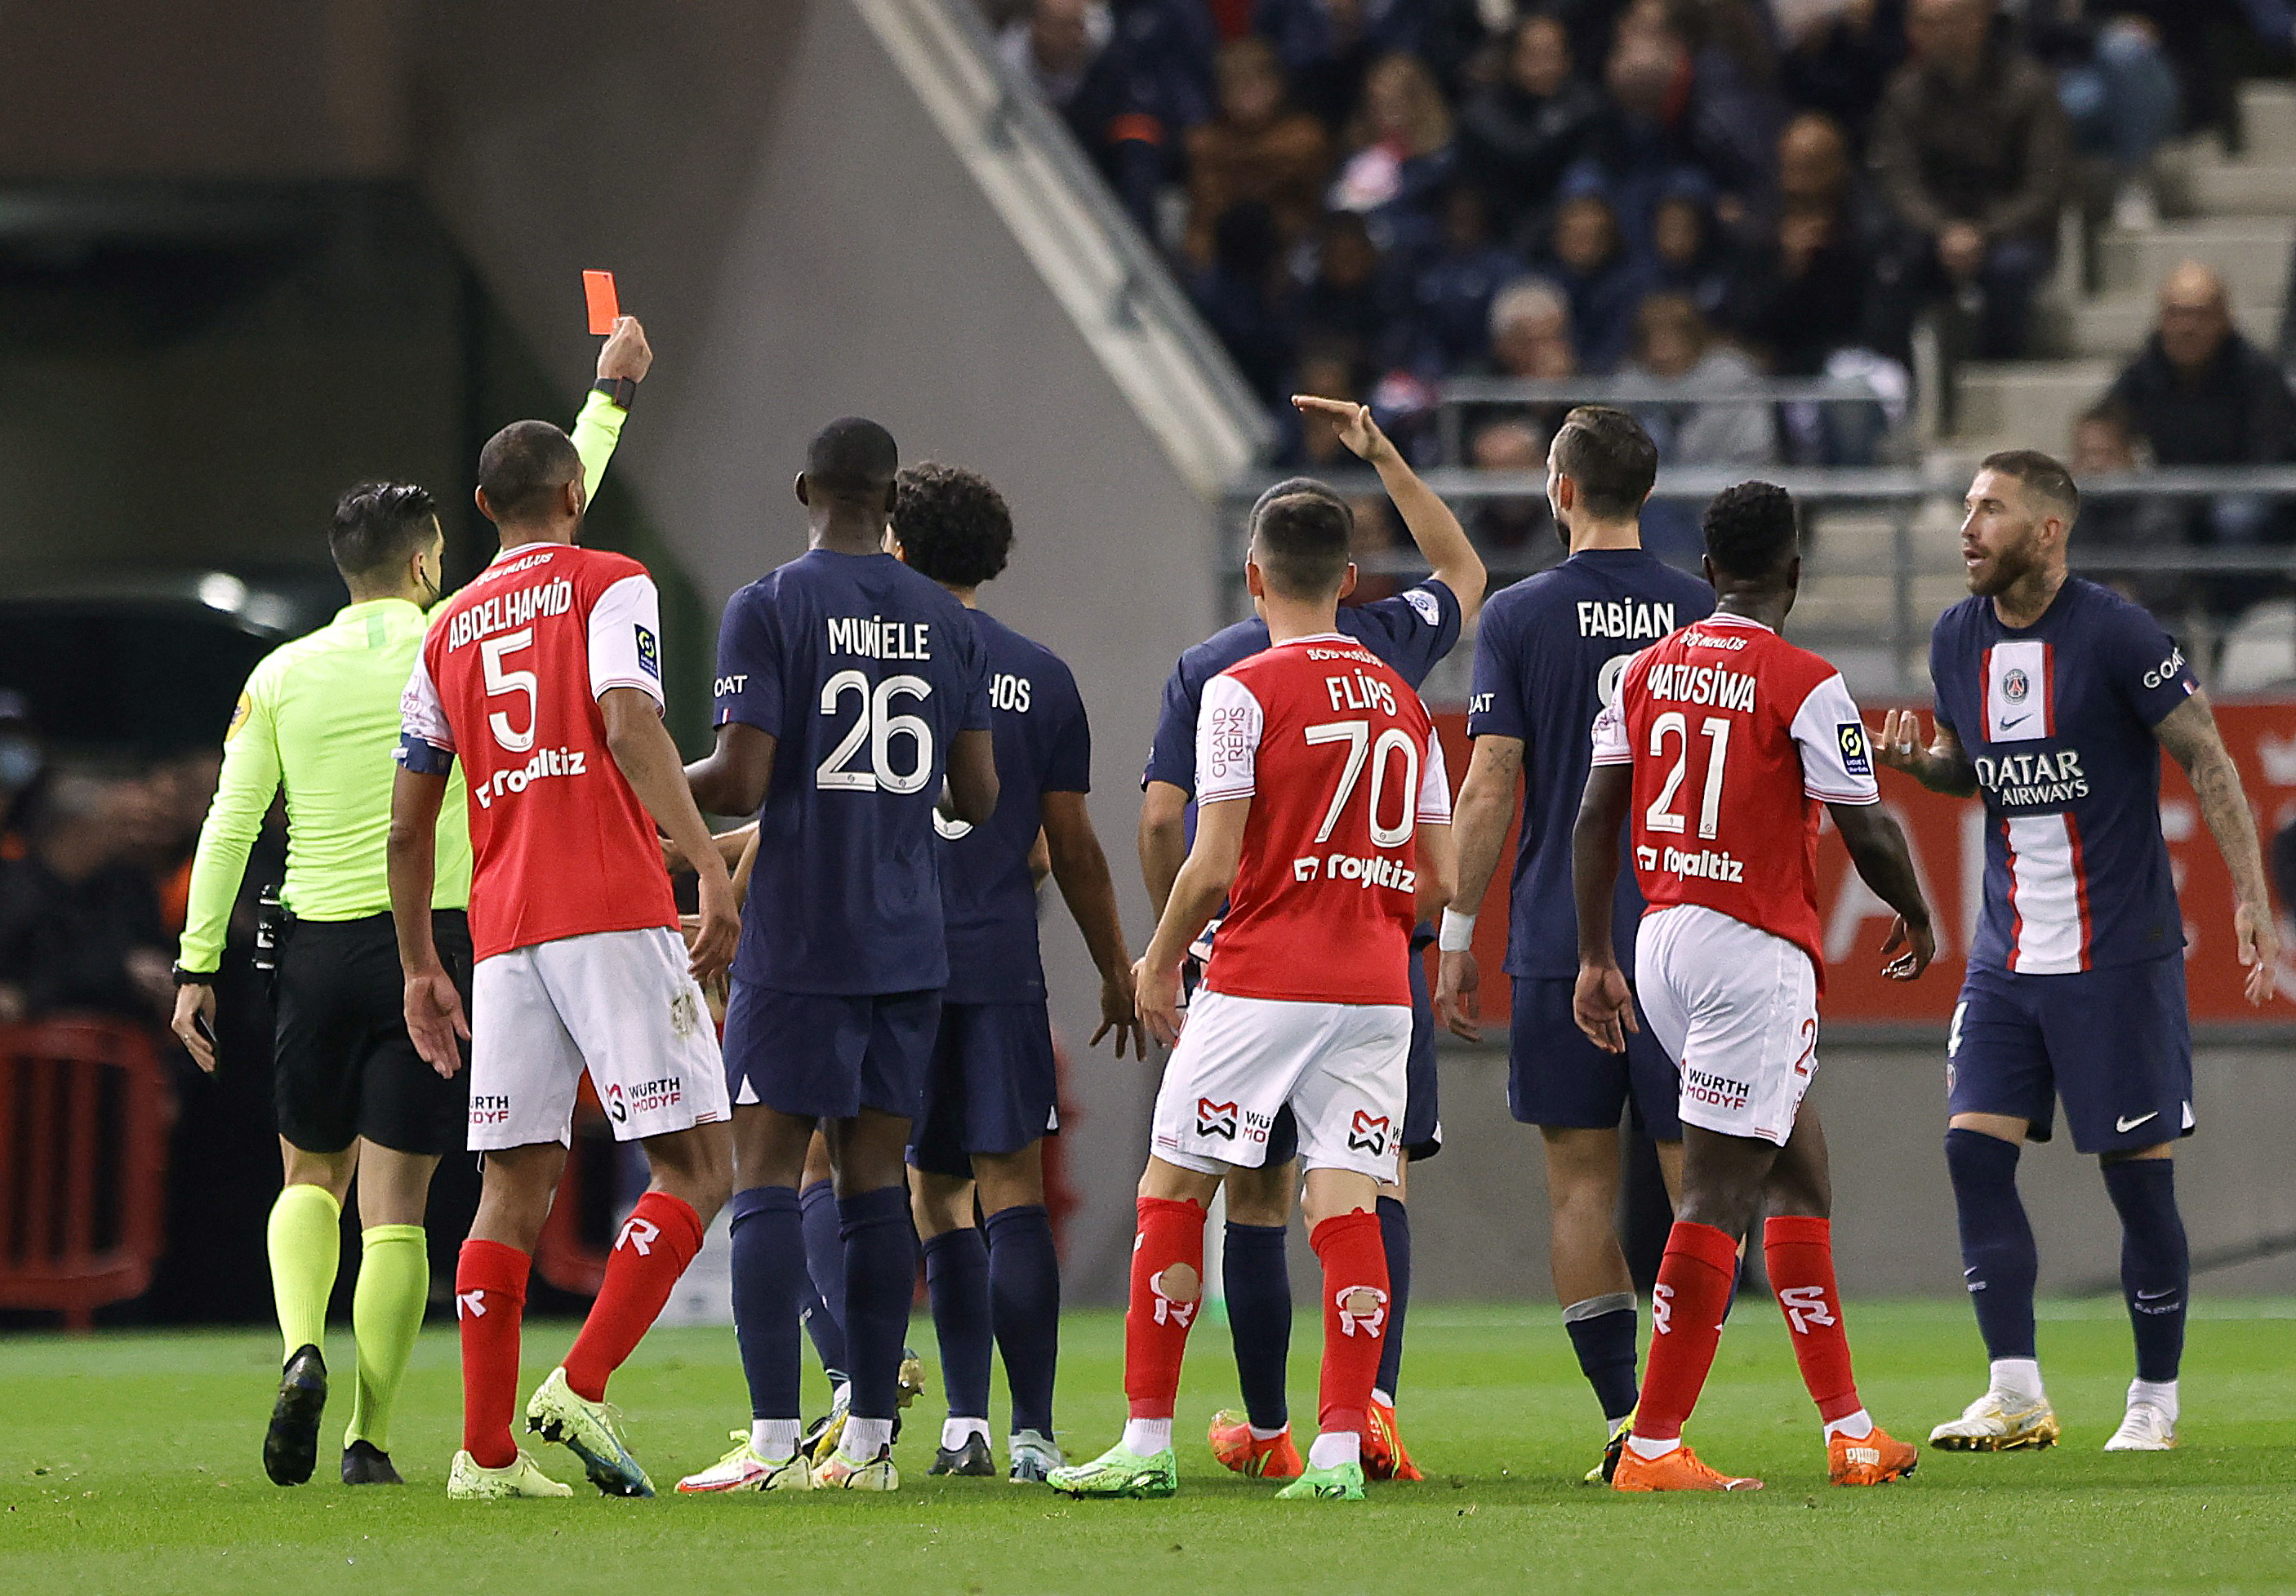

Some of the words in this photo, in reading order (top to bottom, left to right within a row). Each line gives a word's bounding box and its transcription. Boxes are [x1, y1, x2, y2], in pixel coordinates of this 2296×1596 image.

[448, 576, 572, 654] ABDELHAMID
[1577, 597, 1675, 639] FABIAN
[714, 674, 748, 698] OAT
[2143, 647, 2187, 688] GOA
[480, 626, 539, 753] 5
[1325, 668, 1397, 717] FLIPS
[817, 670, 932, 794] 26
[1213, 708, 1226, 778] GRAND
[492, 746, 587, 798] roaltiz
[1305, 720, 1418, 847] 70
[1646, 712, 1730, 839] 21
[1974, 751, 2085, 794] QATAR
[2001, 780, 2090, 806] AIRWAYS
[1794, 1018, 1816, 1078] 2
[629, 1077, 680, 1100] WÜRTH
[633, 1092, 680, 1114] MODYF
[1686, 1084, 1746, 1110] MODYF
[1689, 1068, 1749, 1097] WÜRTH
[1243, 1127, 1266, 1143] MO
[1246, 1111, 1270, 1129] WÜ
